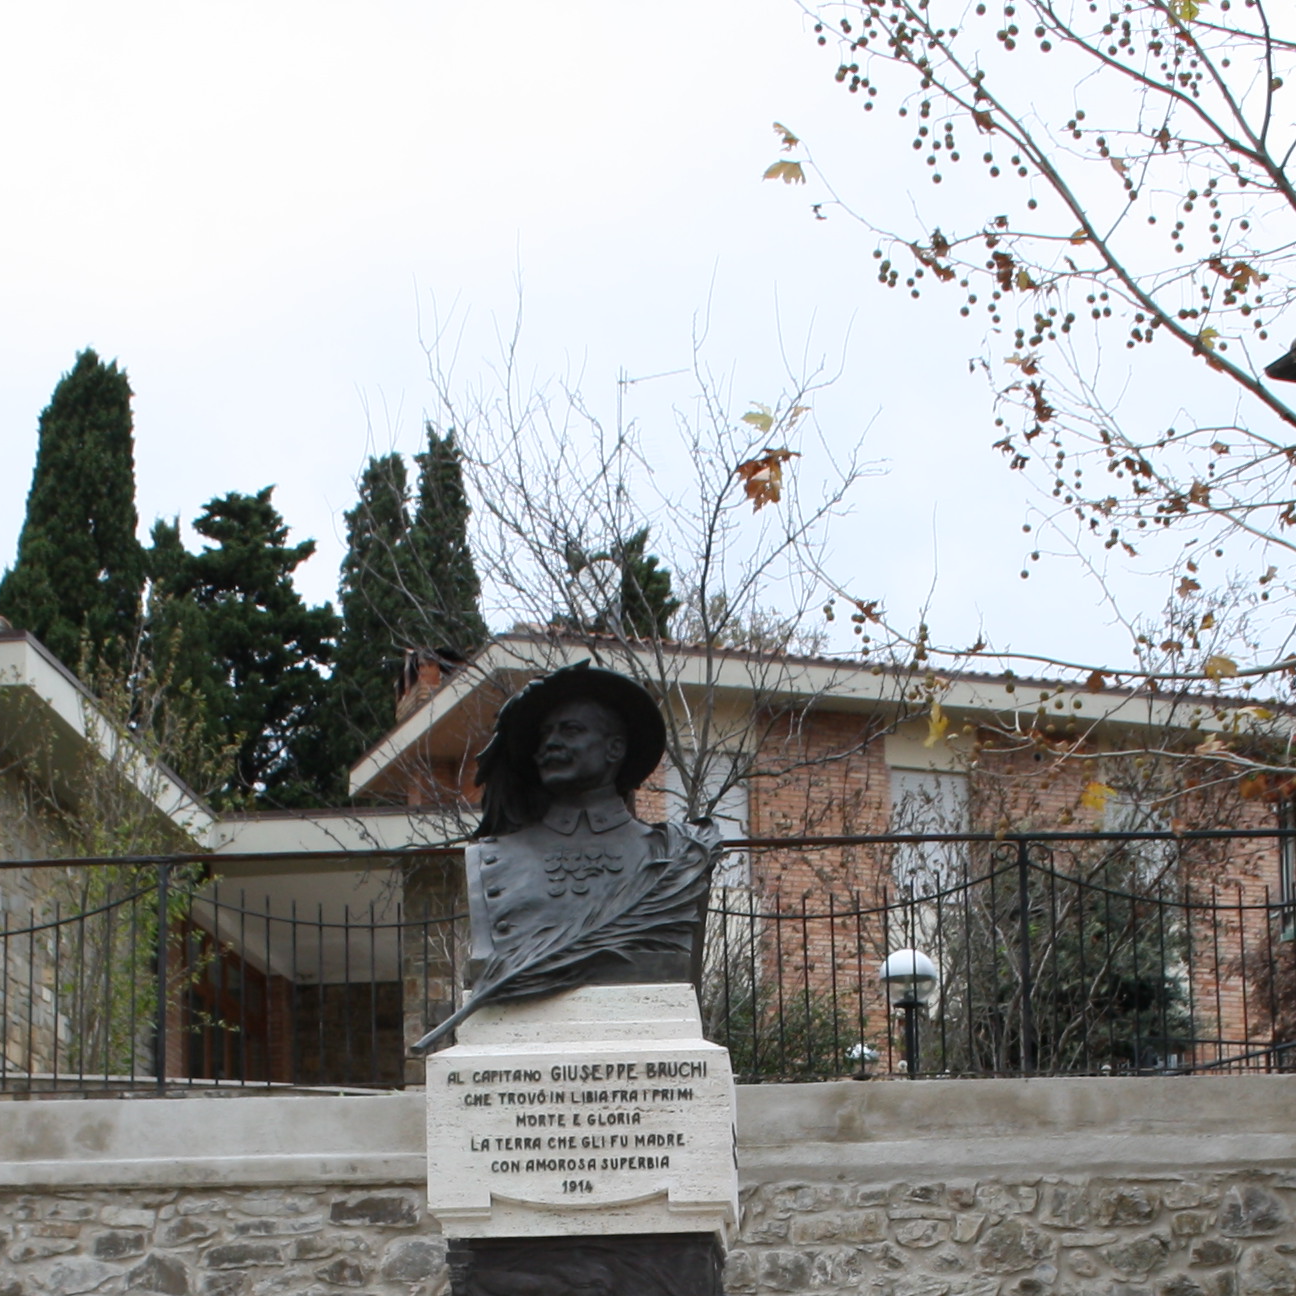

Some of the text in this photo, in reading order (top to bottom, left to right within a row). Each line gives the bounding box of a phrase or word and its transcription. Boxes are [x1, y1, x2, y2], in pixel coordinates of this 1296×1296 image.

[447, 1061, 707, 1086] AL CAPITANO GIUSEPPE BRUCHI
[464, 1093, 493, 1107] CHE
[550, 1091, 565, 1104] IN
[571, 1090, 608, 1104] LIBIA
[611, 1089, 638, 1102] FRA
[643, 1089, 647, 1101] I
[653, 1087, 693, 1101] PRIMI
[516, 1112, 641, 1127] MORTE E GLORIA
[471, 1133, 686, 1152] LA TERRA CHE GLI FU MADRE
[491, 1155, 670, 1173] CON AMOROSA SUPERBIA
[561, 1180, 593, 1194] 1914
